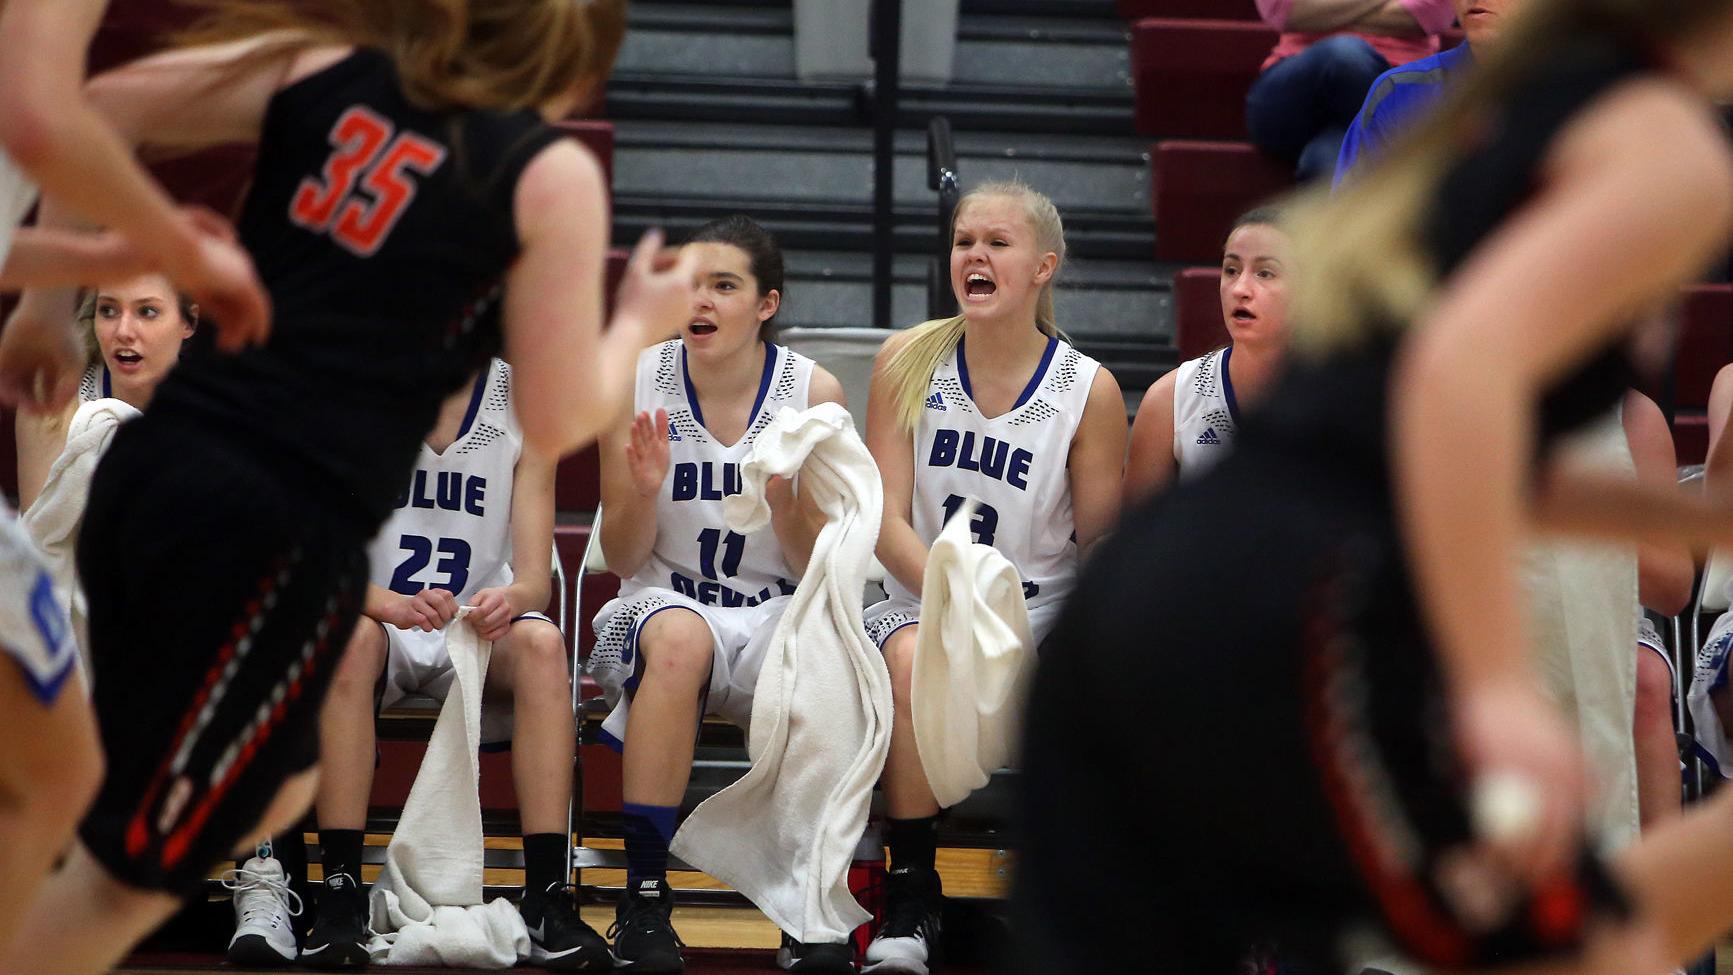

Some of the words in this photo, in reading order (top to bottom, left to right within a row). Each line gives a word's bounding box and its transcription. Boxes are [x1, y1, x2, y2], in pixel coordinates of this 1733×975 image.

[289, 104, 448, 257] 35
[672, 461, 743, 501] BLU
[928, 428, 1034, 491] BLUE
[388, 534, 472, 598] 23
[696, 527, 746, 581] 11
[640, 879, 659, 889] NIKE
